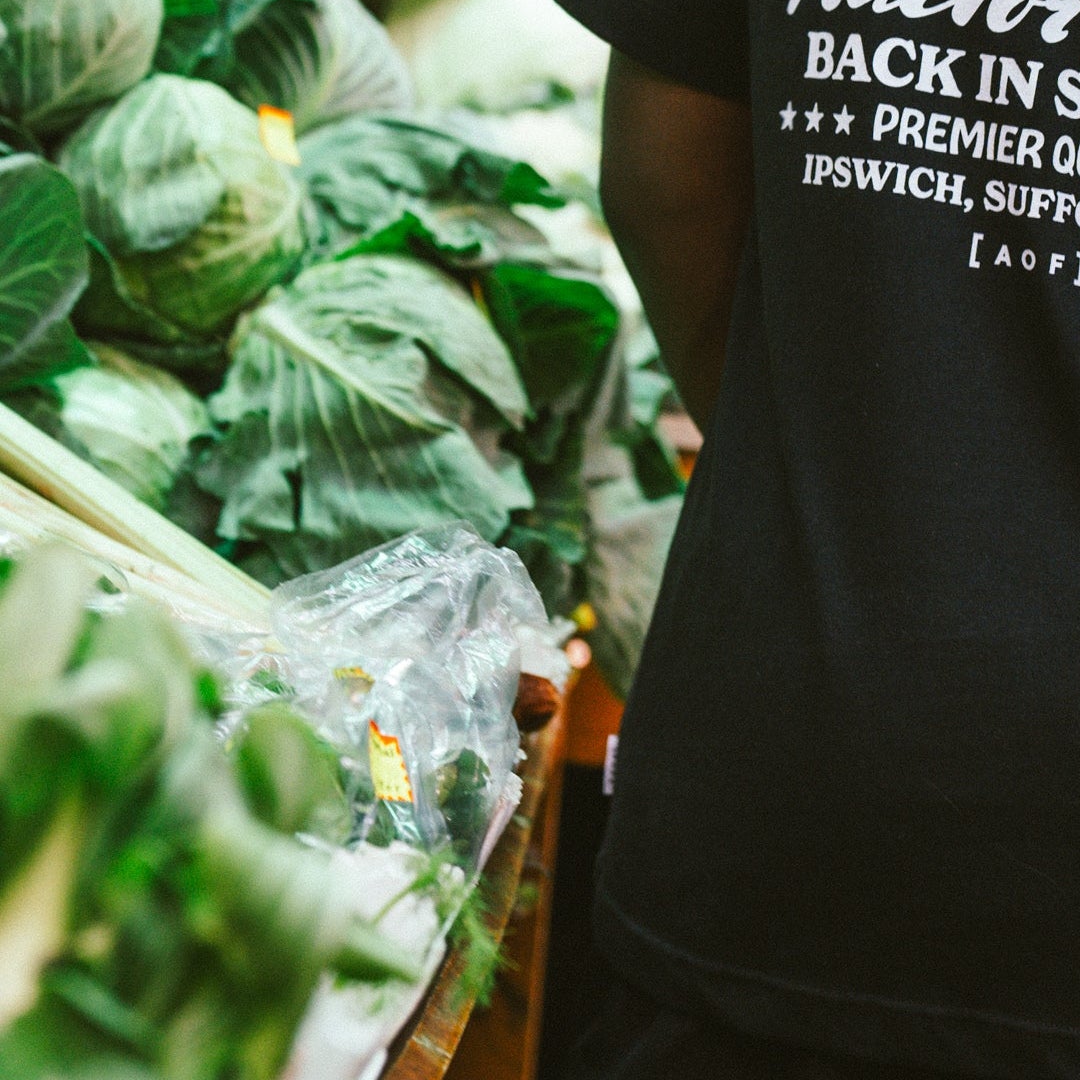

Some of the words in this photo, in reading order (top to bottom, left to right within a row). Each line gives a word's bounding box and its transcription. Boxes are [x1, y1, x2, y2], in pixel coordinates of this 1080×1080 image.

[803, 31, 967, 99] BACK
[976, 53, 1044, 110] IN
[872, 103, 1044, 169] PREMIER
[802, 153, 974, 213] IPSWICH,
